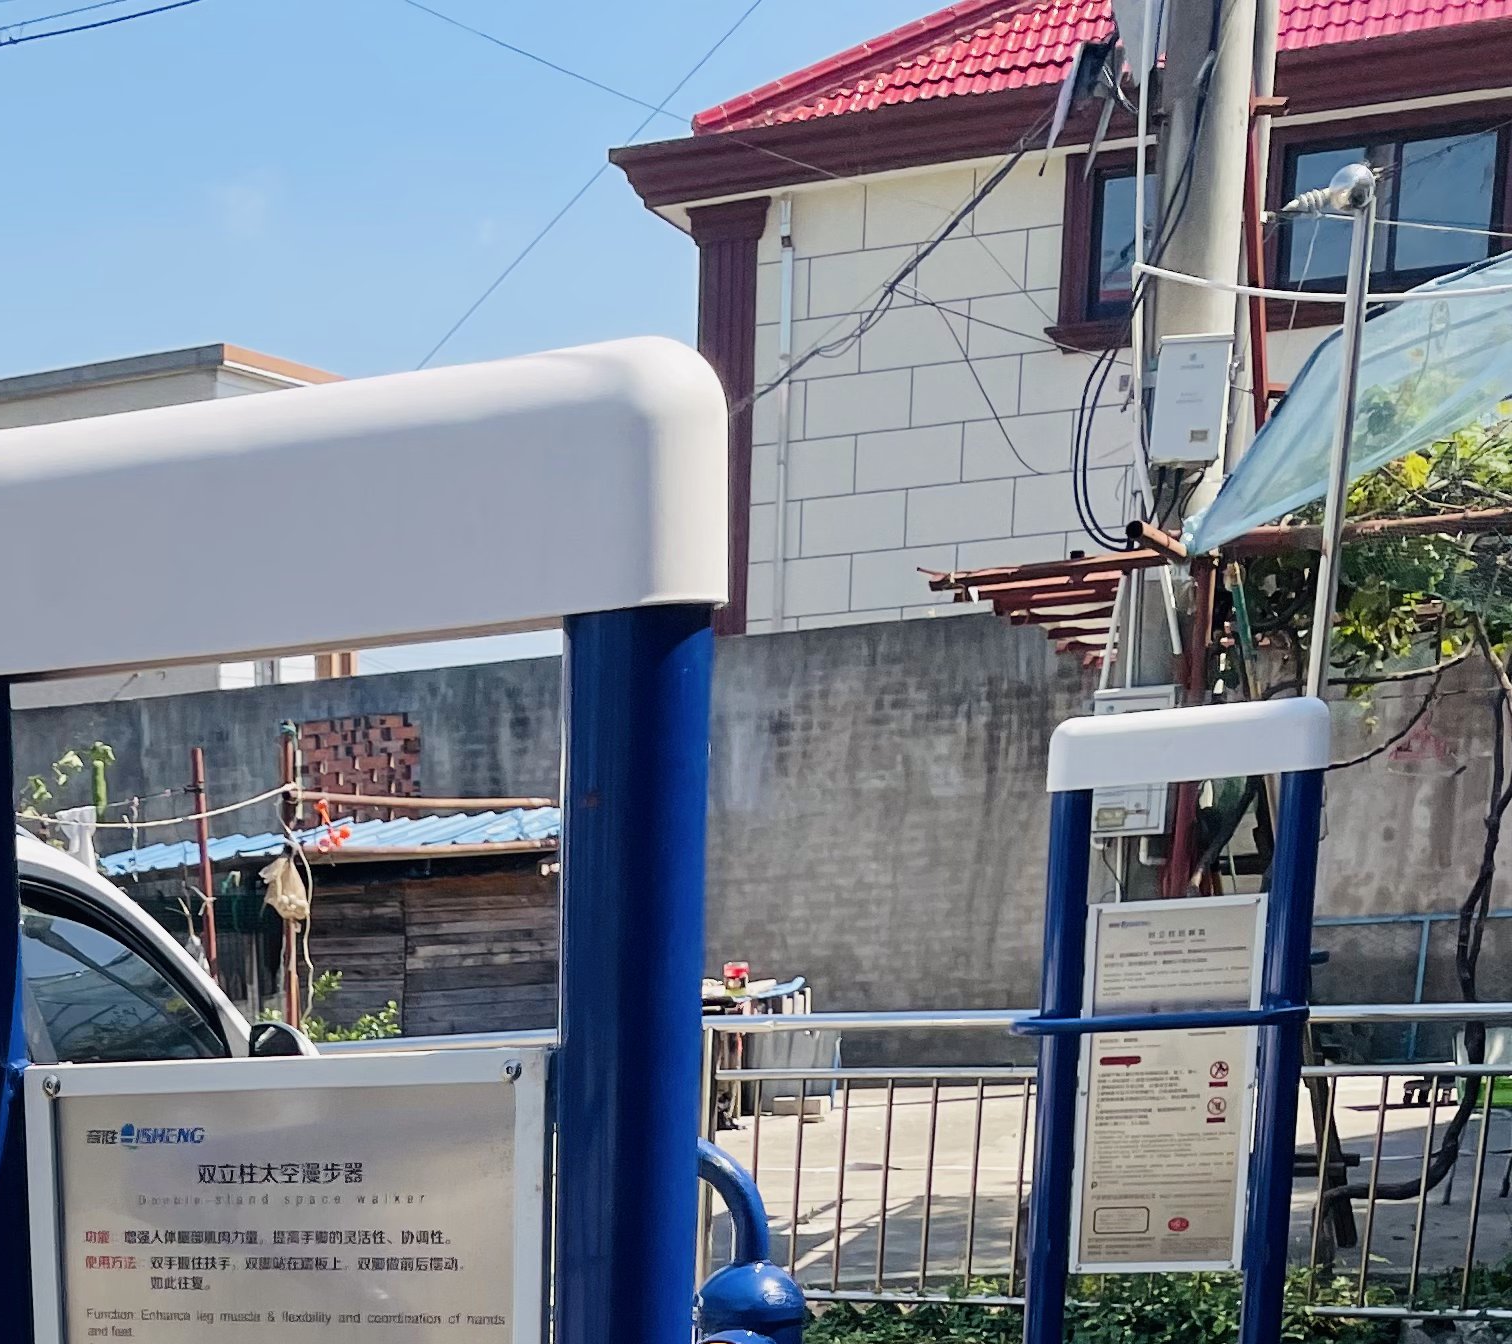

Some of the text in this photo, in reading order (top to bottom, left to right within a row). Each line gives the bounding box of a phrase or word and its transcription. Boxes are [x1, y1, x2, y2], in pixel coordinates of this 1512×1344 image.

[198, 1162, 363, 1184] 双立柱太空漫步器
[356, 1194, 425, 1205] walker
[338, 1312, 361, 1324] and
